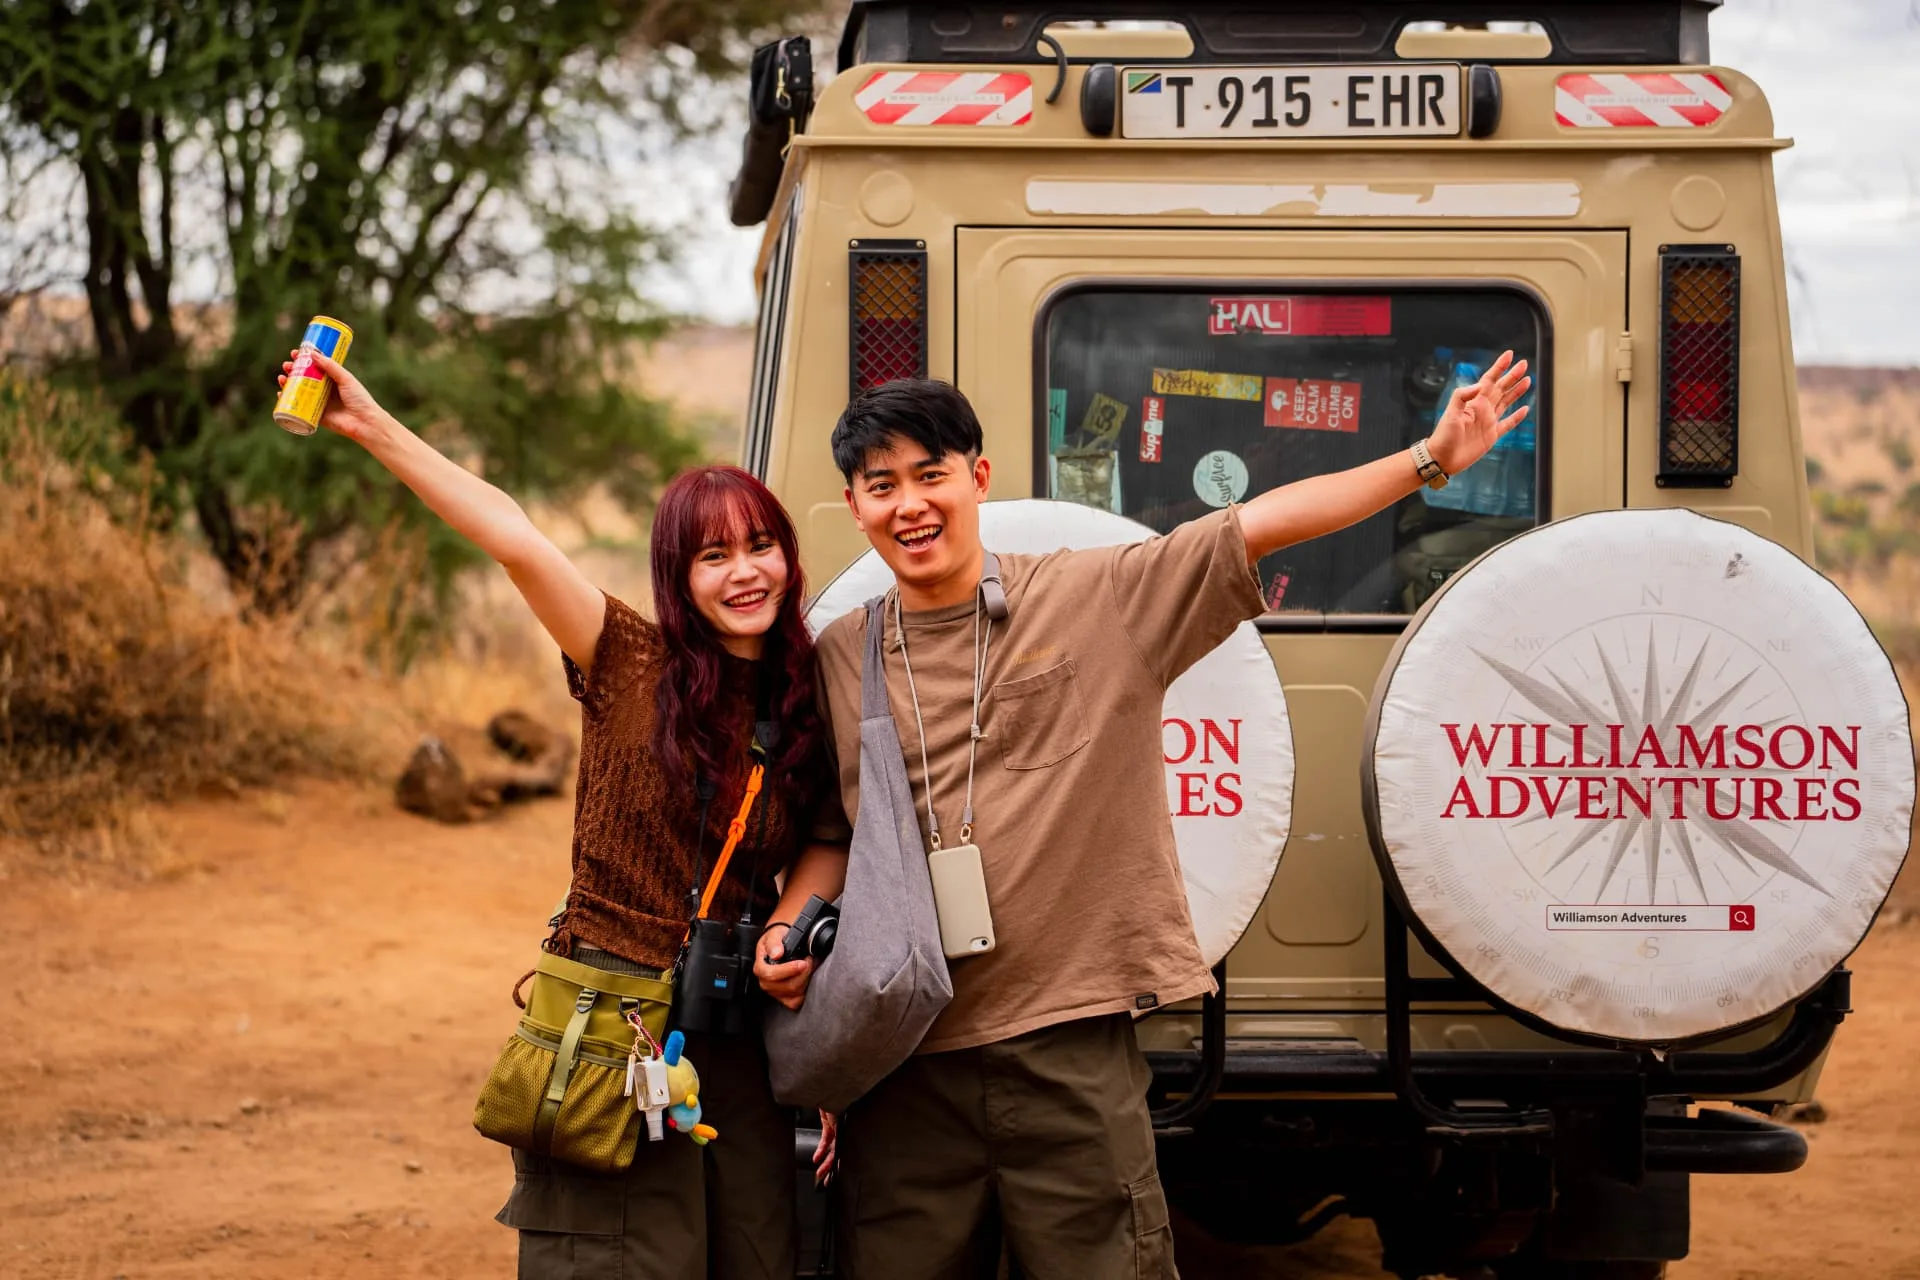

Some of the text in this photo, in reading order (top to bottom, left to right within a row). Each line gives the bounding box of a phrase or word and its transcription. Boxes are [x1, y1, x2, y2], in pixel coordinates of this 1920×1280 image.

[1166, 75, 1446, 128] T 915 EHR
[1216, 303, 1282, 329] HAL
[1293, 385, 1307, 421] KEEP
[1306, 384, 1321, 425] CALM
[1328, 384, 1342, 428] CLIMB
[1341, 395, 1354, 419] ON
[1140, 400, 1160, 460] Supme
[1640, 584, 1663, 608] N
[1767, 638, 1793, 652] NE
[1439, 722, 1862, 769] WILLIAMSON
[1439, 775, 1862, 820] ADVENTURES
[1424, 874, 1446, 900] 240
[1553, 911, 1688, 923] Williamson Adventures
[1476, 941, 1504, 963] 220
[1643, 937, 1660, 958] S
[1550, 986, 1577, 1004] 200
[1716, 991, 1743, 1008] 160
[1632, 1006, 1658, 1019] 180
